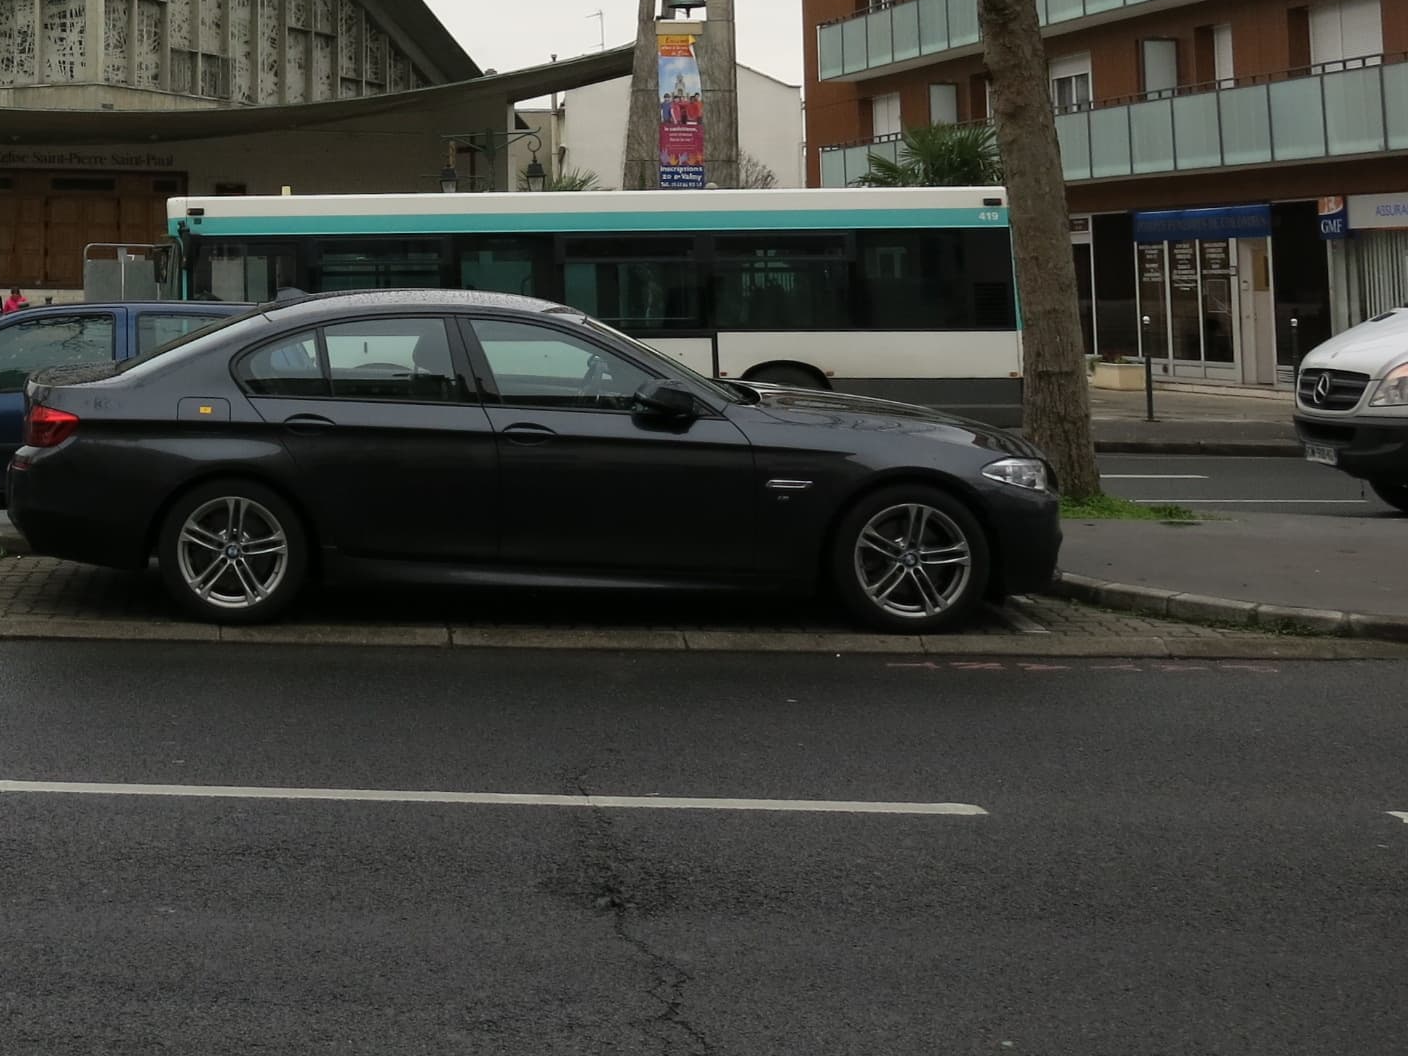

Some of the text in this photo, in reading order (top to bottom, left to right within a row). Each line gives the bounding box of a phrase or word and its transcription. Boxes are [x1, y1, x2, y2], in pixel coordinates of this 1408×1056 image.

[32, 151, 107, 165] Saint-Pierre
[111, 153, 174, 166] Saint-Paul
[978, 212, 999, 221] 419
[1321, 219, 1343, 234] GMF
